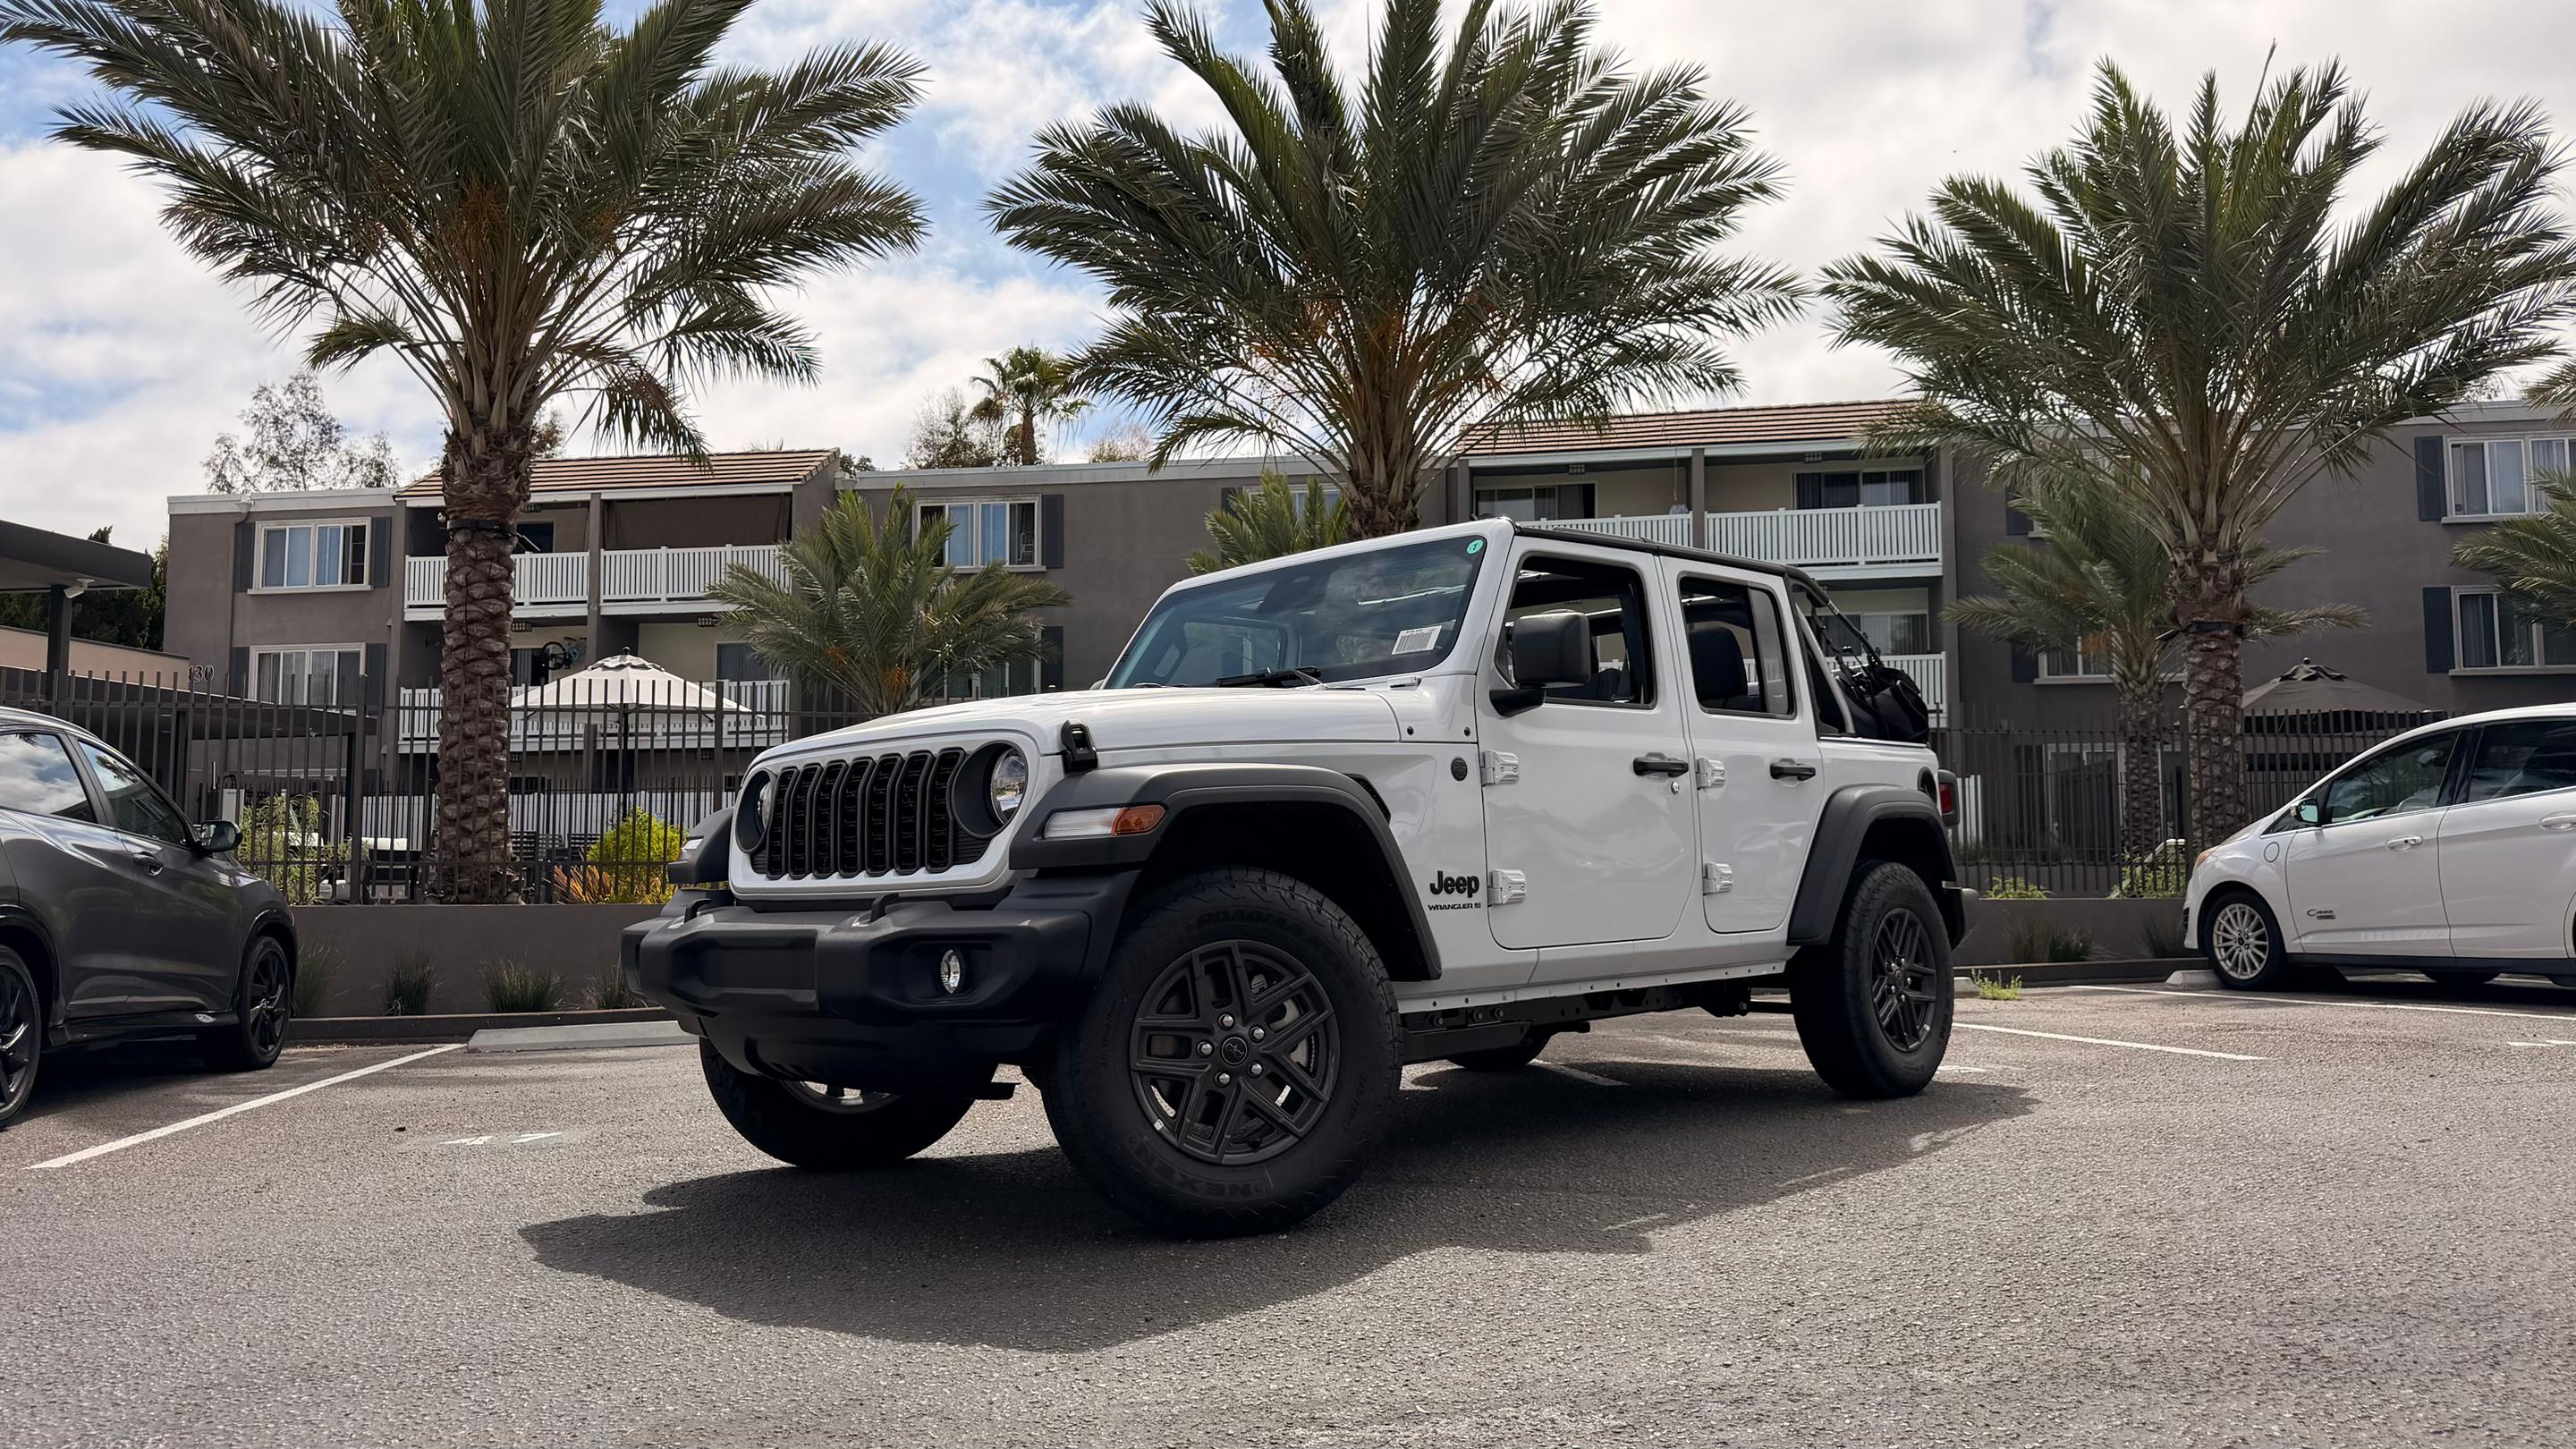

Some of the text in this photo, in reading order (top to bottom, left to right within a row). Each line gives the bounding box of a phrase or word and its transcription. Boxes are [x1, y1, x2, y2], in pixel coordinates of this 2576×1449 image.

[1429, 869, 1480, 899] Jeep
[1428, 902, 1474, 911] WRANGLER
[1139, 1141, 1252, 1198] NEXEN
